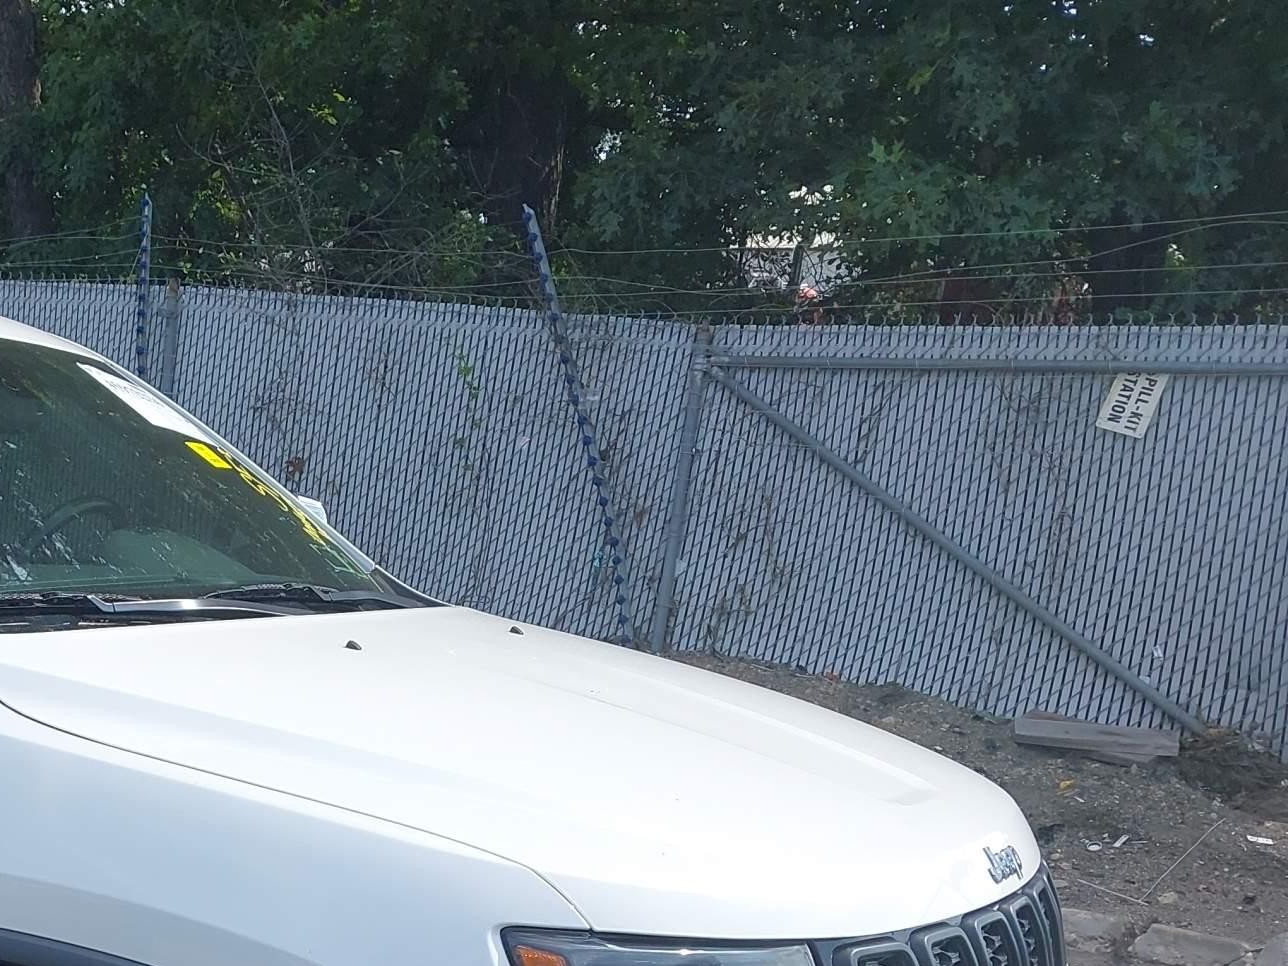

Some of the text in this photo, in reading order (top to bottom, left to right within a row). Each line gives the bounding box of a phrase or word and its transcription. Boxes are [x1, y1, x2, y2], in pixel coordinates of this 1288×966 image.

[1106, 371, 1142, 424] STATION
[1123, 372, 1159, 433] PILL-KIT
[982, 844, 1024, 885] Jeep
